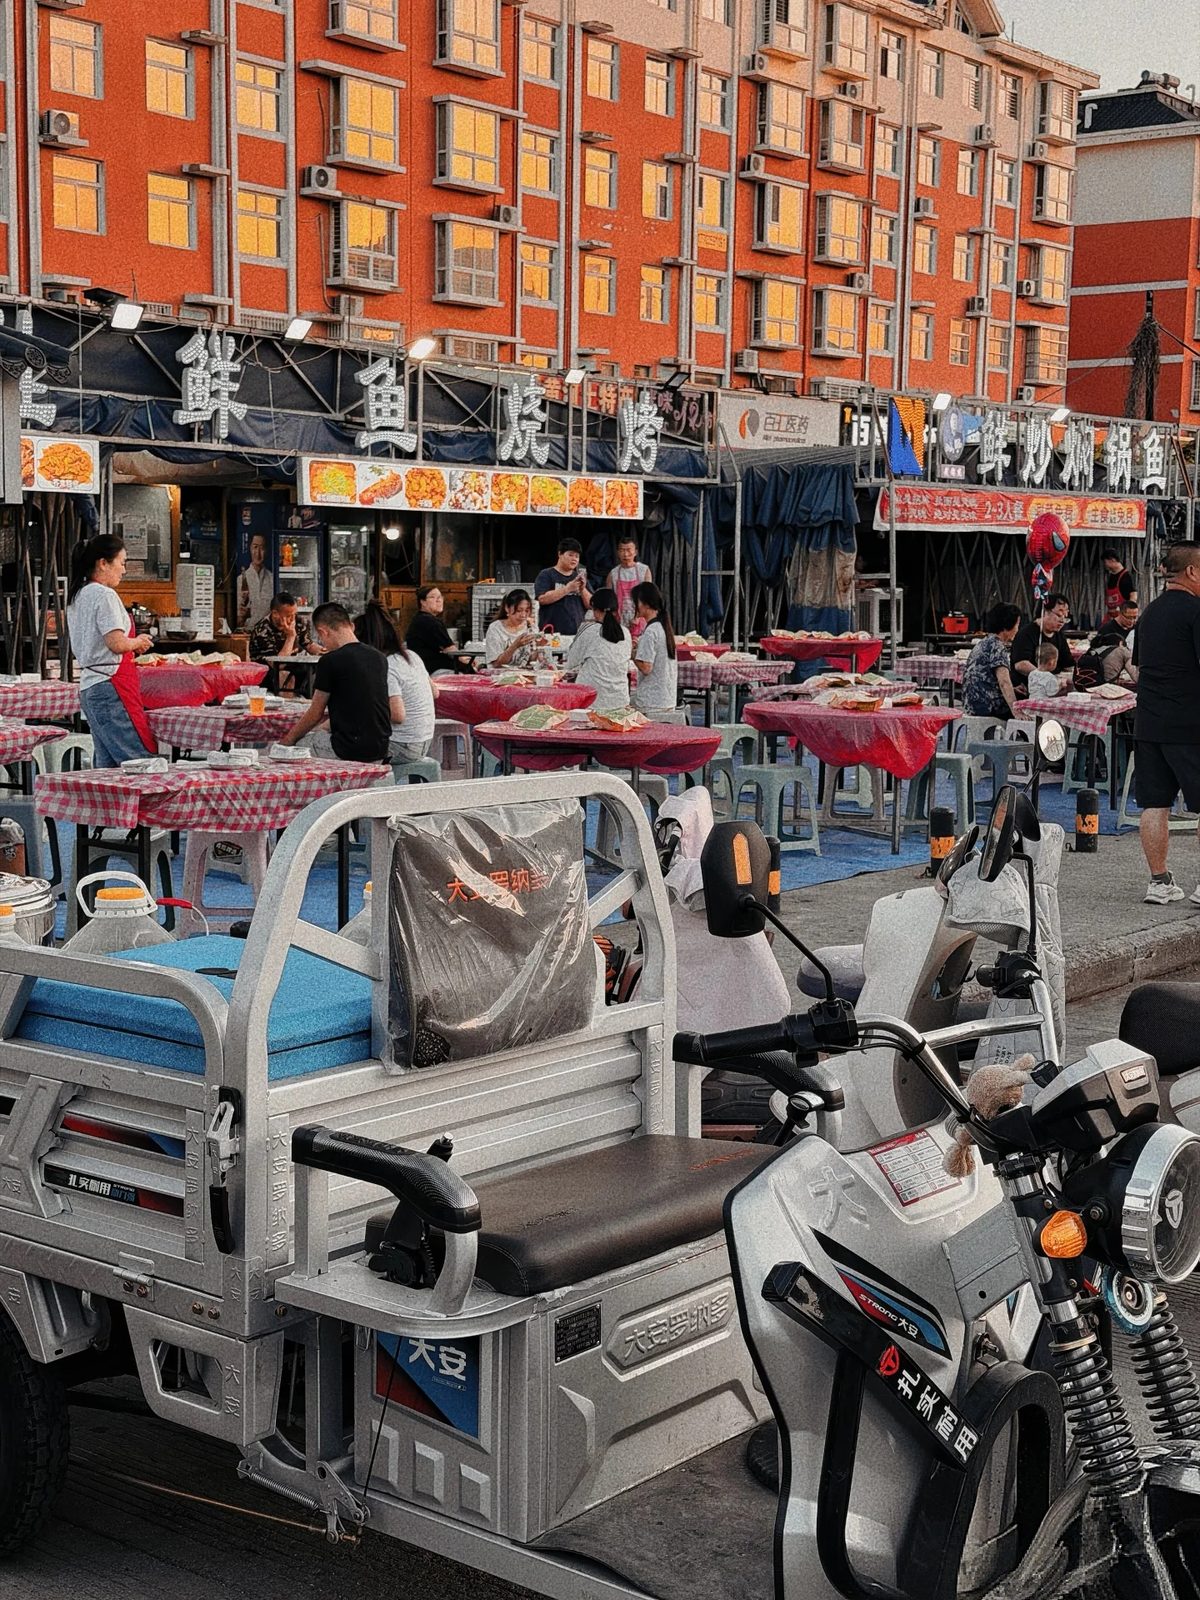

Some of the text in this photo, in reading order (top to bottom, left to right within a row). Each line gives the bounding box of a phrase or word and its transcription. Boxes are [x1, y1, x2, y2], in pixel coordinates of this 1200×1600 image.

[977, 409, 1167, 491] 鲜炒焖锅鱼
[446, 867, 551, 904] 大罗纳多
[68, 1173, 112, 1196] 扎实耐用
[271, 1130, 289, 1252] 大安罗纳多
[807, 1165, 871, 1231] 大
[624, 1291, 729, 1361] 大安罗纳多
[858, 1293, 920, 1340] STRONG 大安
[408, 1338, 467, 1382] 大安
[225, 1363, 241, 1418] 大安
[896, 1368, 979, 1462] 扎实耐用
